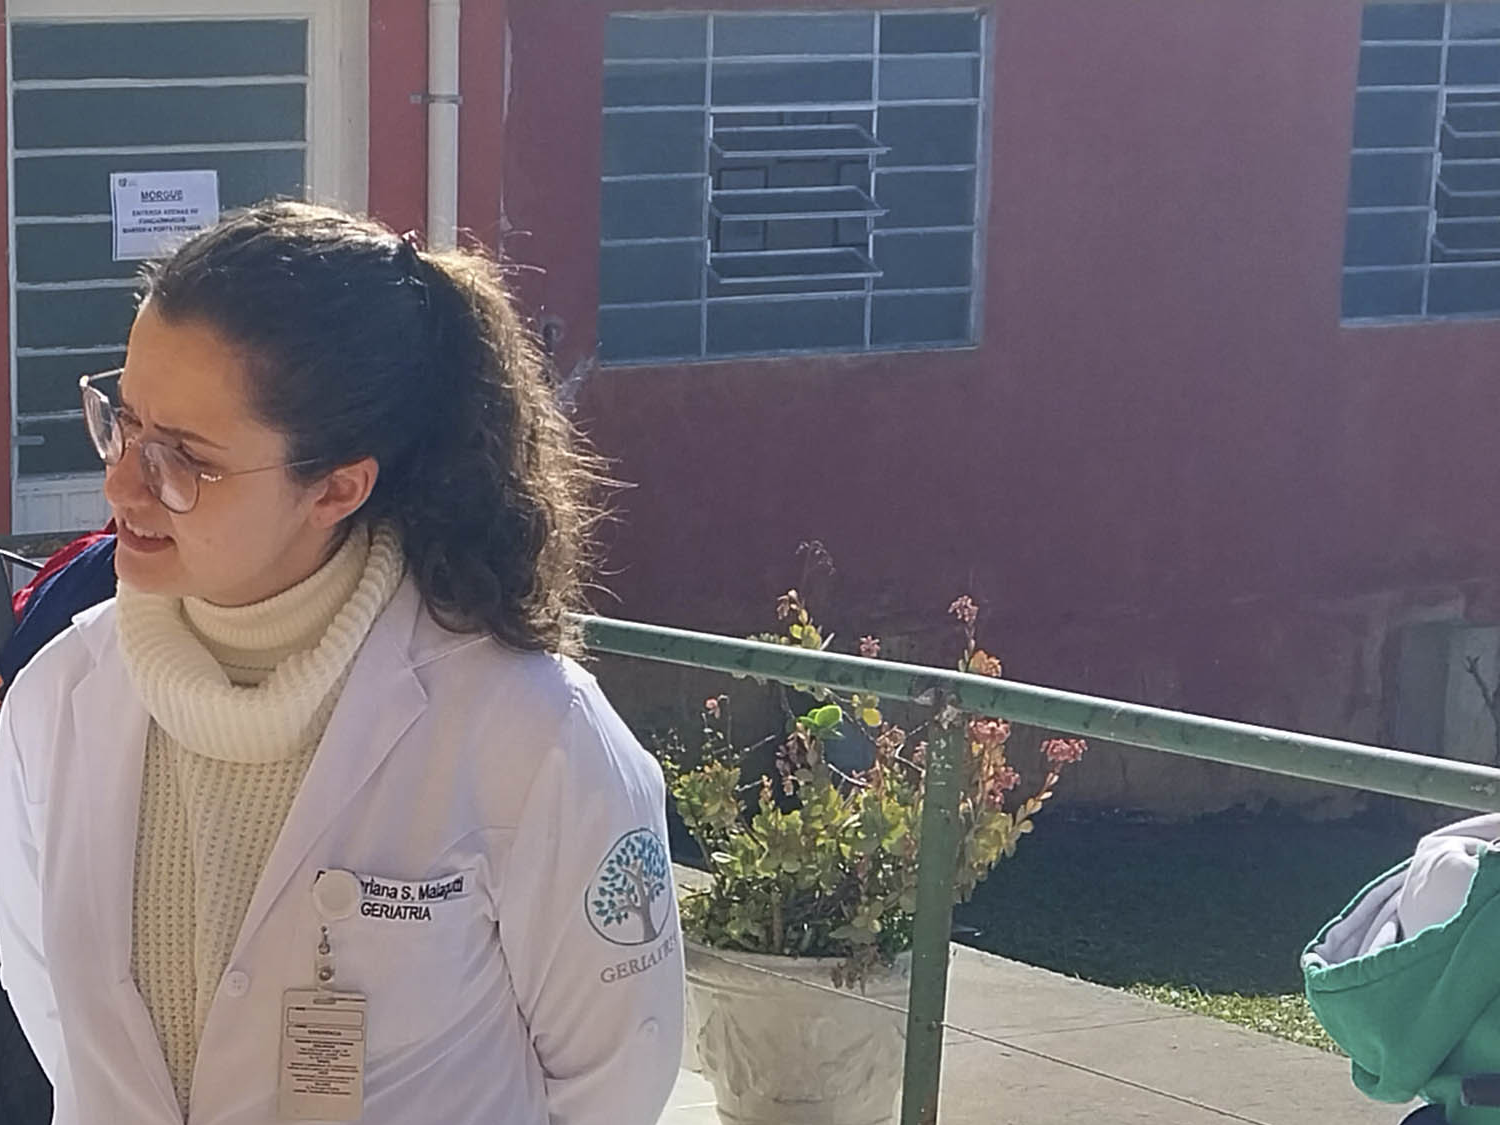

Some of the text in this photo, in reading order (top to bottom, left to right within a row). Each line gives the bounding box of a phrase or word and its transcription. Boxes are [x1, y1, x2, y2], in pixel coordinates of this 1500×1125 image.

[141, 190, 183, 202] MORGUE
[360, 878, 398, 900] riana
[401, 886, 415, 900] S.
[361, 902, 432, 920] GERIATRIA
